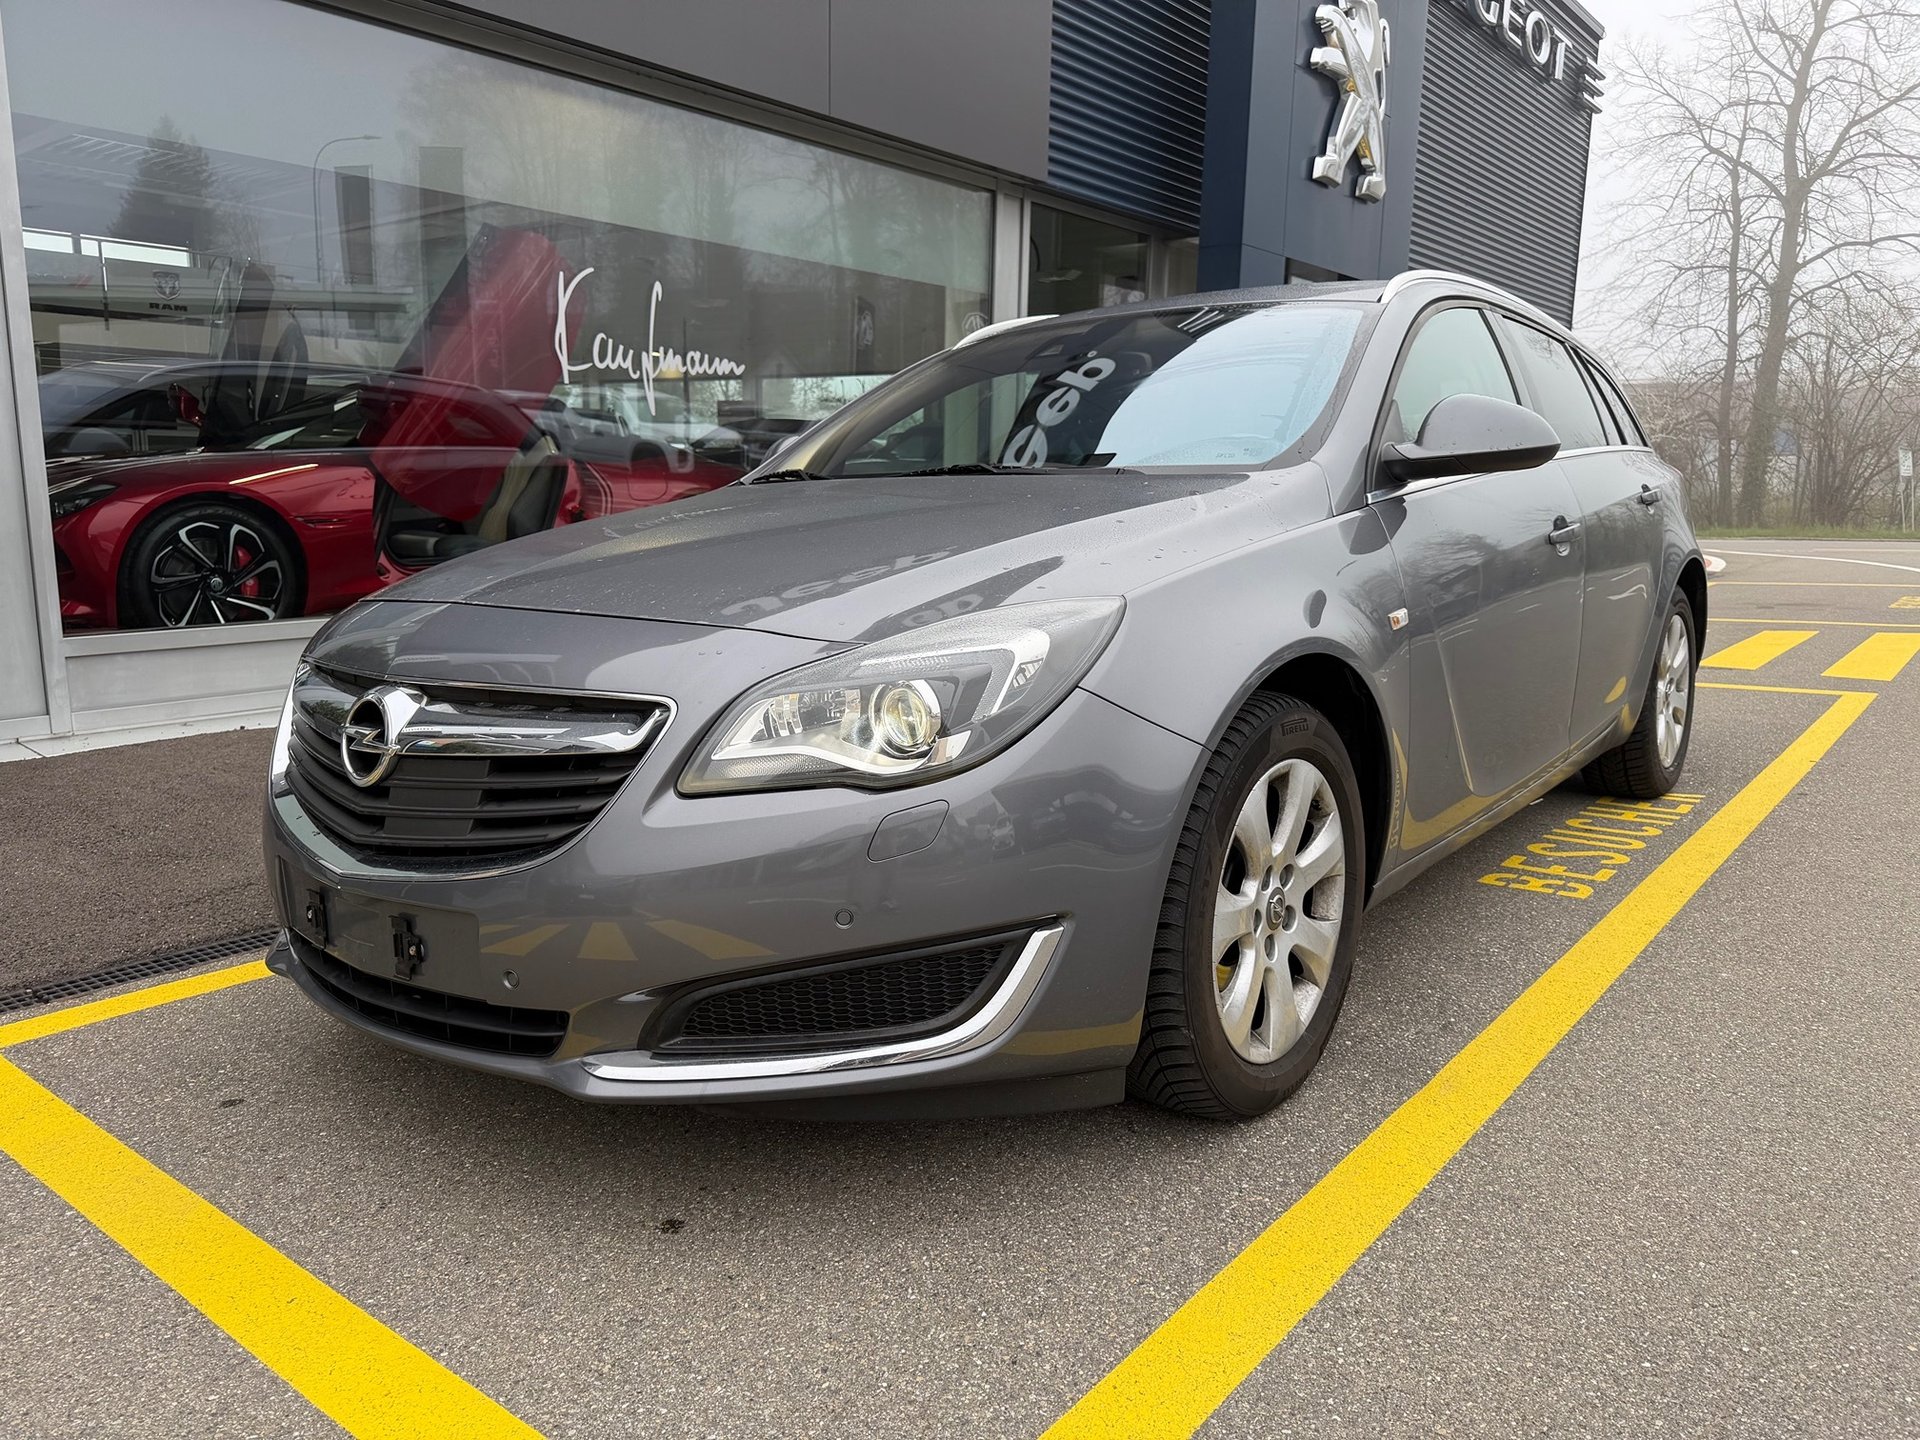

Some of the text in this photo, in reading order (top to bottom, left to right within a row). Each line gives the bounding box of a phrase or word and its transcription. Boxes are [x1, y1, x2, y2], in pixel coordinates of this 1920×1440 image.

[148, 302, 189, 312] RAM
[555, 267, 746, 416] Kaufmann
[1280, 717, 1309, 737] PIRELLI
